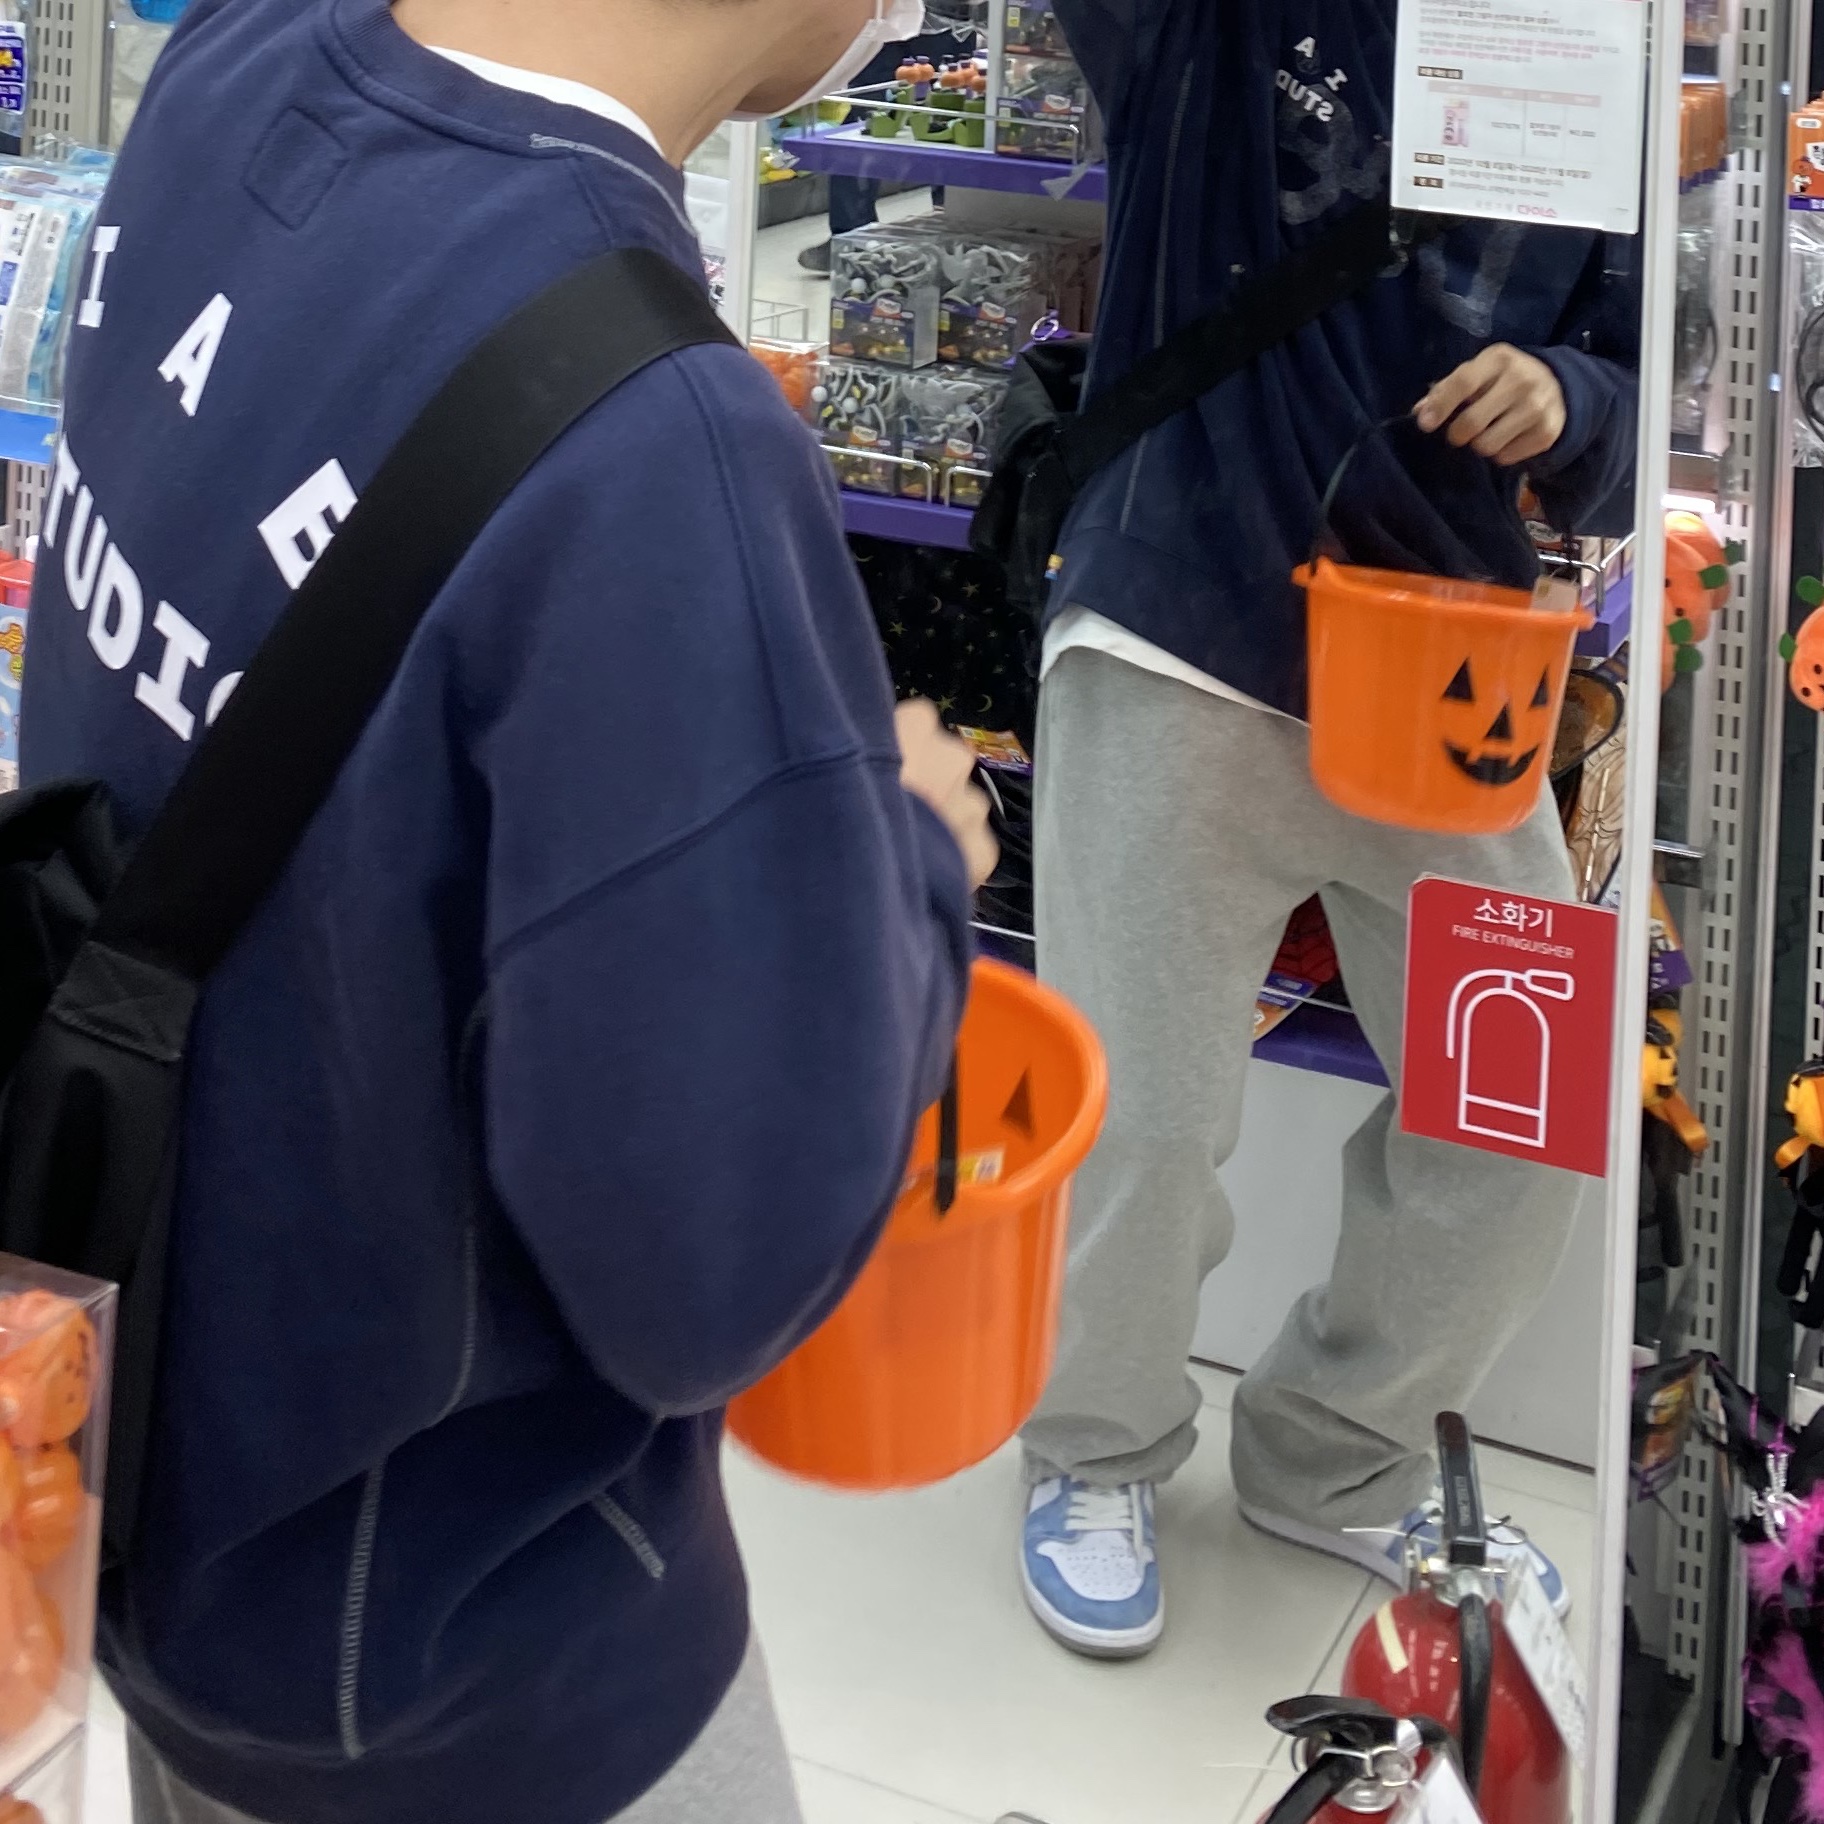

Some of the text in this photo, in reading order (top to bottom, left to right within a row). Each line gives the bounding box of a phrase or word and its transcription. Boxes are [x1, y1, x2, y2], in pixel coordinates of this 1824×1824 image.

[44, 431, 245, 741] TUDI
[1473, 898, 1554, 938] 소화기
[1451, 924, 1575, 959] FIRE EXTINGUISHER
